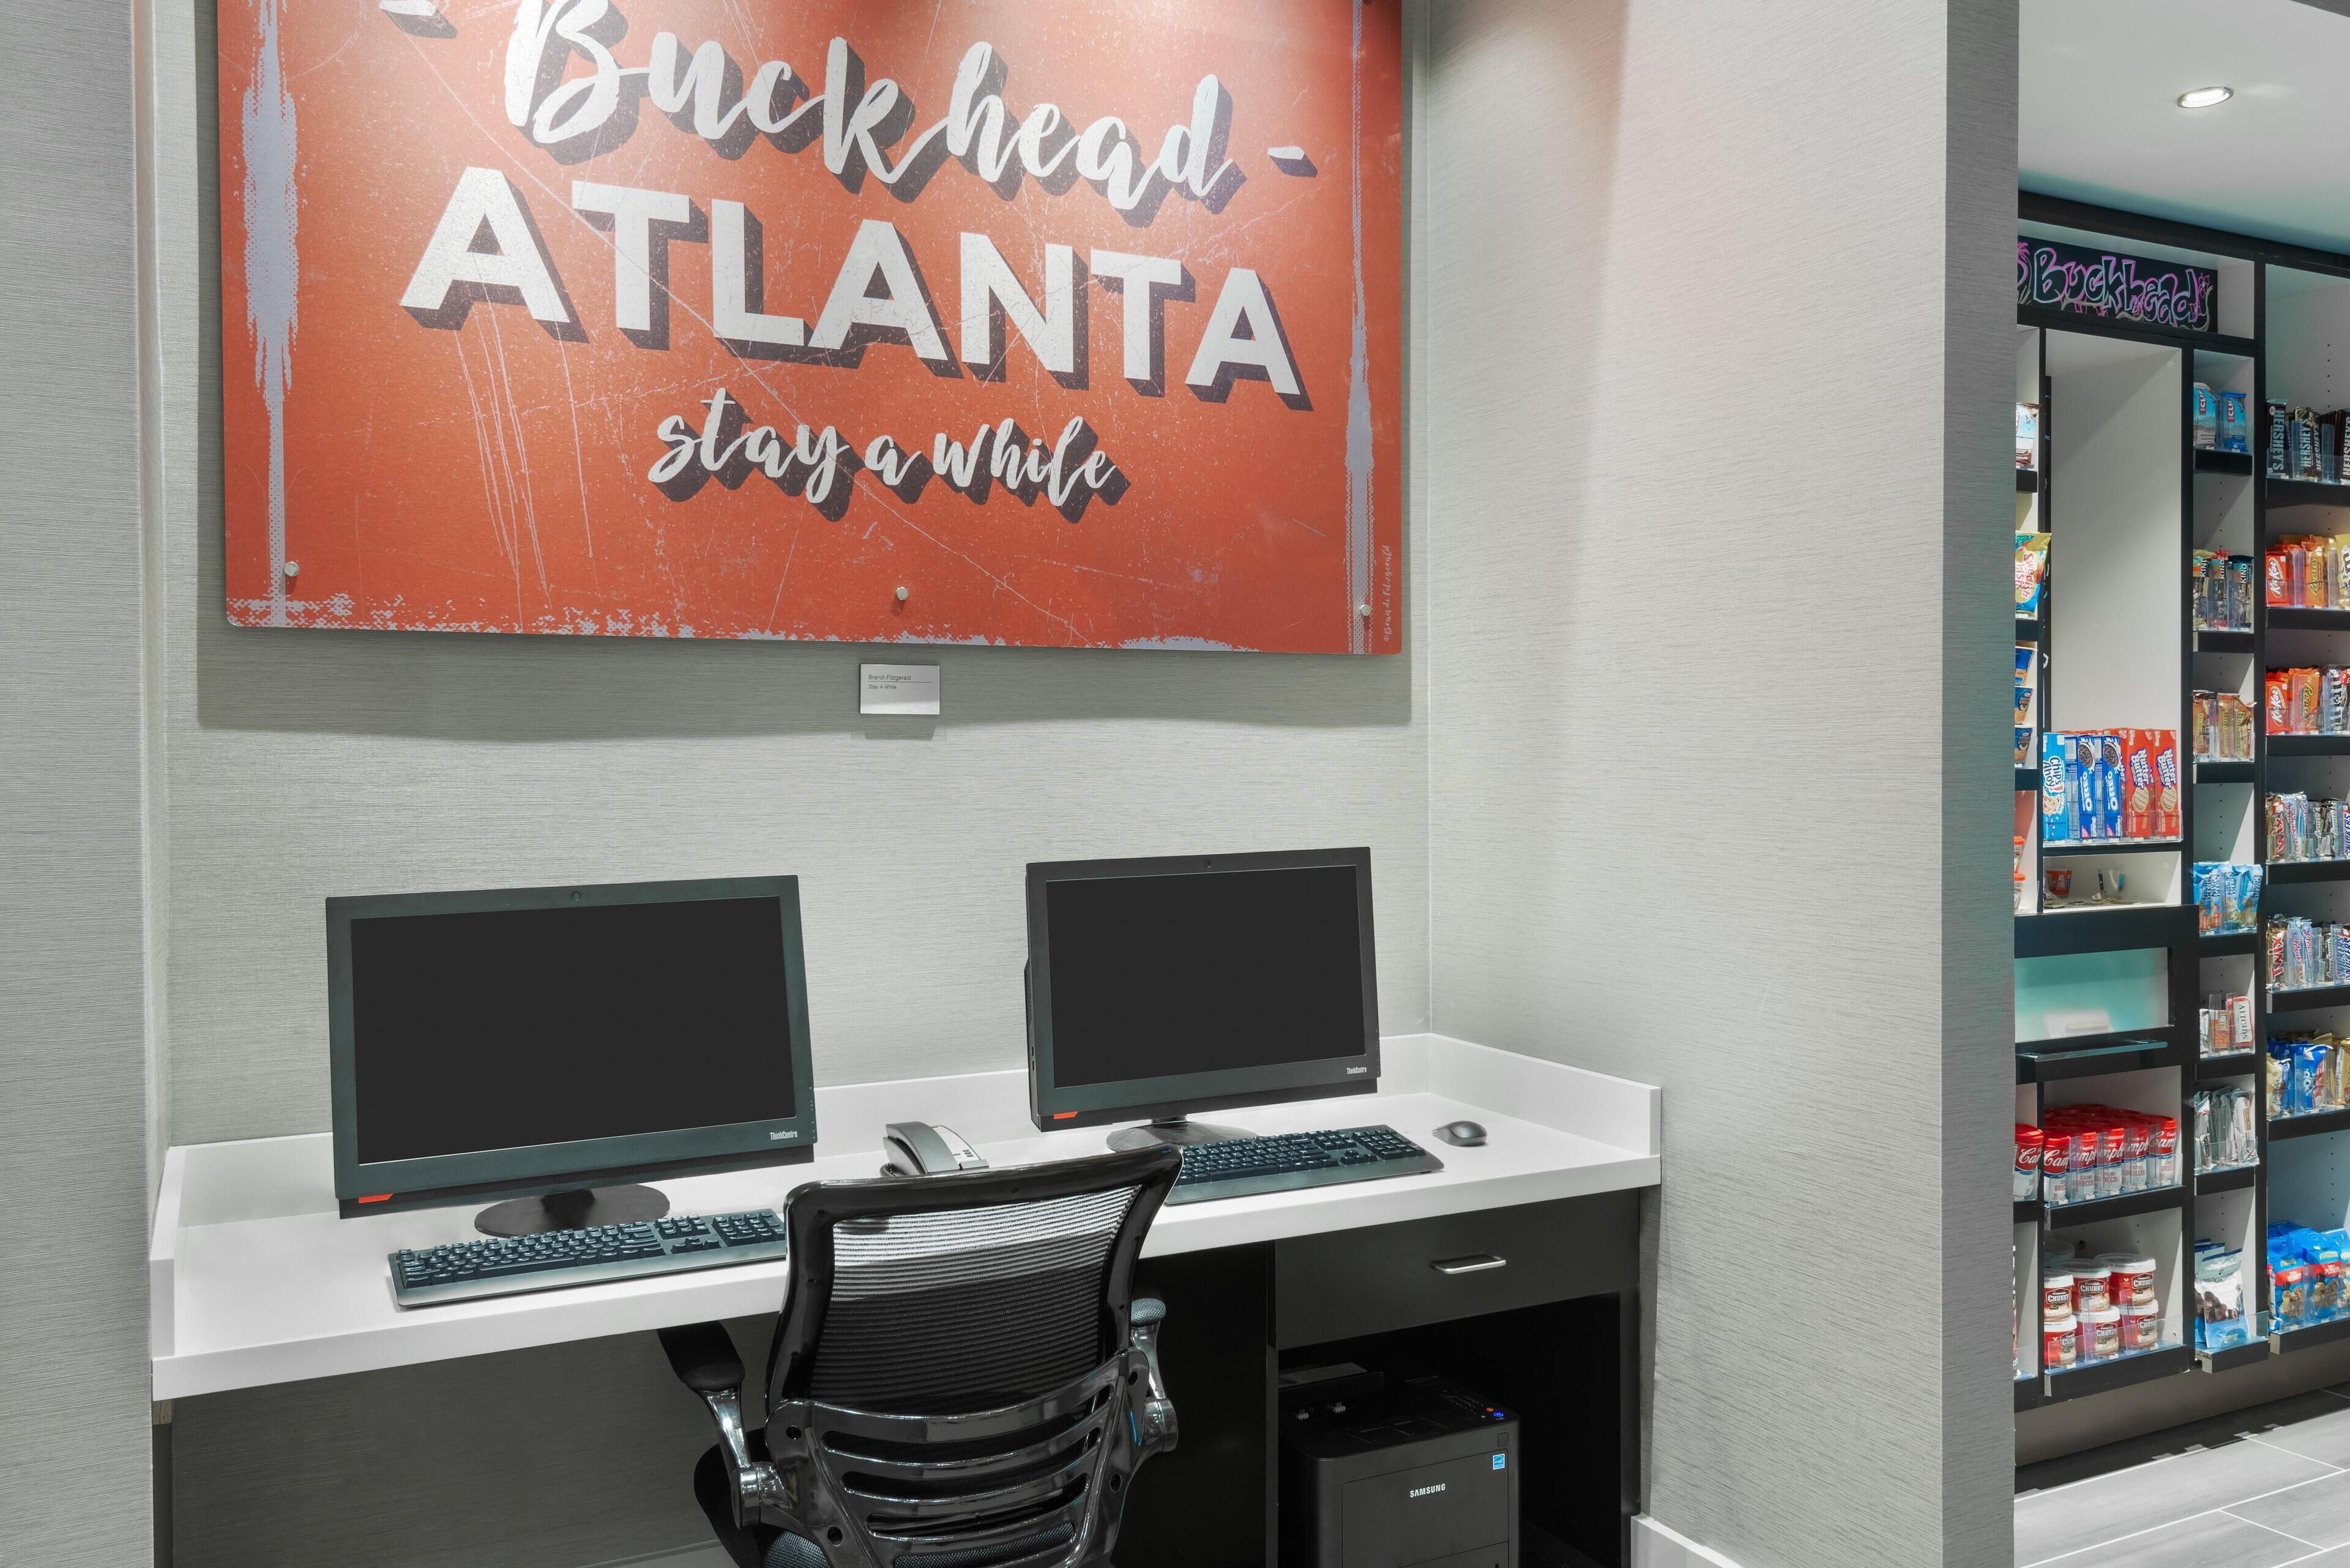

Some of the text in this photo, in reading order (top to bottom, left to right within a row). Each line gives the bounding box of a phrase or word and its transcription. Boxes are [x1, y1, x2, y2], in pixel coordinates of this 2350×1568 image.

[504, 0, 1234, 210] Buckhead
[398, 166, 1301, 397] ATLANTA
[2033, 247, 2199, 329] Buckhead
[647, 388, 849, 503] stay
[864, 432, 922, 486] a
[2272, 410, 2285, 471] HERSHEY'S
[2300, 419, 2311, 467] HERSHEY'S
[2022, 553, 2035, 597] Swedish
[2050, 756, 2062, 785] Chips
[2130, 754, 2144, 790] Butter
[2137, 748, 2149, 785] Nutter
[2157, 755, 2172, 789] Butter
[2163, 748, 2176, 784] Nutter
[2082, 771, 2092, 812] OREO
[2107, 771, 2118, 811] OREO
[2239, 1004, 2248, 1039] ALTOIDS
[769, 1130, 798, 1141] ThinkCentre
[2048, 1294, 2069, 1302] CHUNKY
[2080, 1284, 2104, 1293] CHUNKY
[2133, 1278, 2152, 1288] CHUNKY
[1409, 1483, 1446, 1498] SAMSUNG
